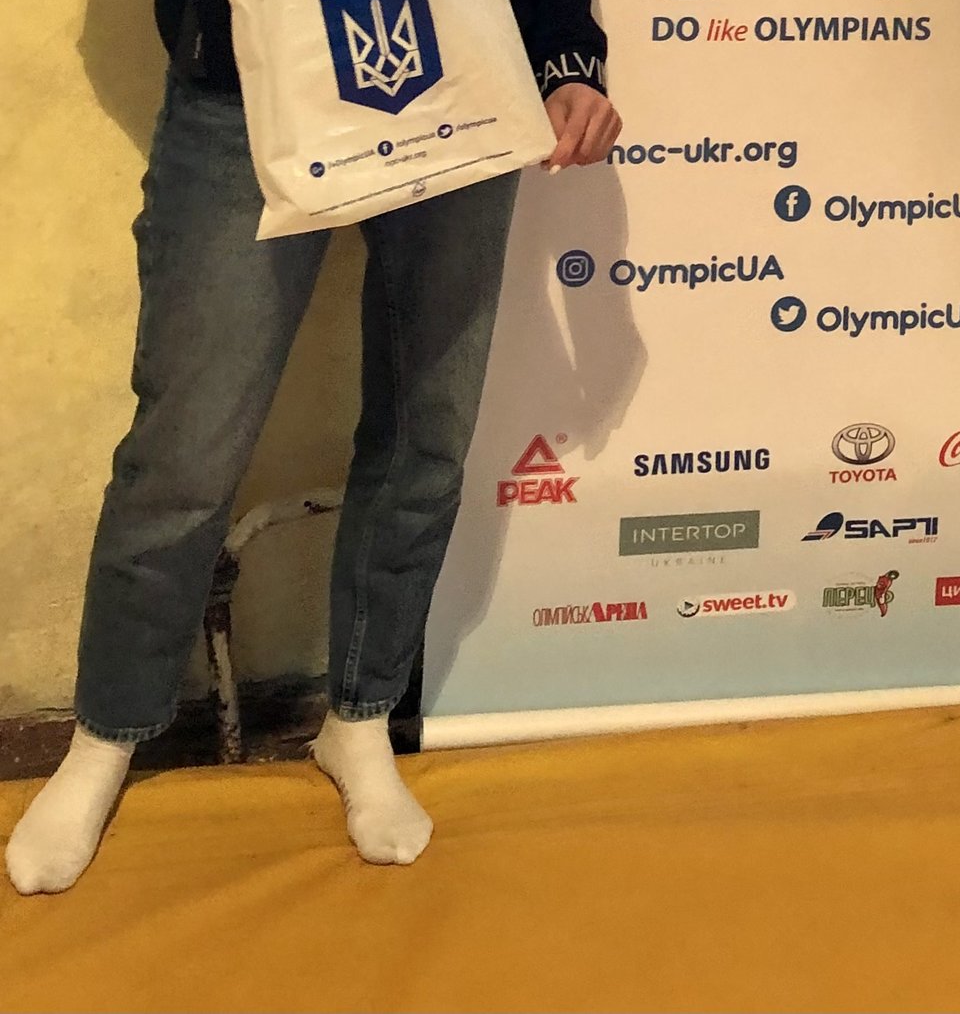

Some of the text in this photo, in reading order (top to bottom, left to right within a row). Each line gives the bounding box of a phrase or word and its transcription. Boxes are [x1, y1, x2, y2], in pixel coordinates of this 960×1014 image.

[651, 16, 932, 42] DO like OLYMPIANS
[606, 137, 798, 168] noc-ukr.org
[609, 255, 785, 292] OympicUA
[633, 447, 771, 477] SAMSUNG
[828, 468, 898, 484] TOYOTA
[496, 476, 581, 507] PEAK
[632, 523, 746, 544] INTERTOP
[702, 593, 789, 614] sweet.tv
